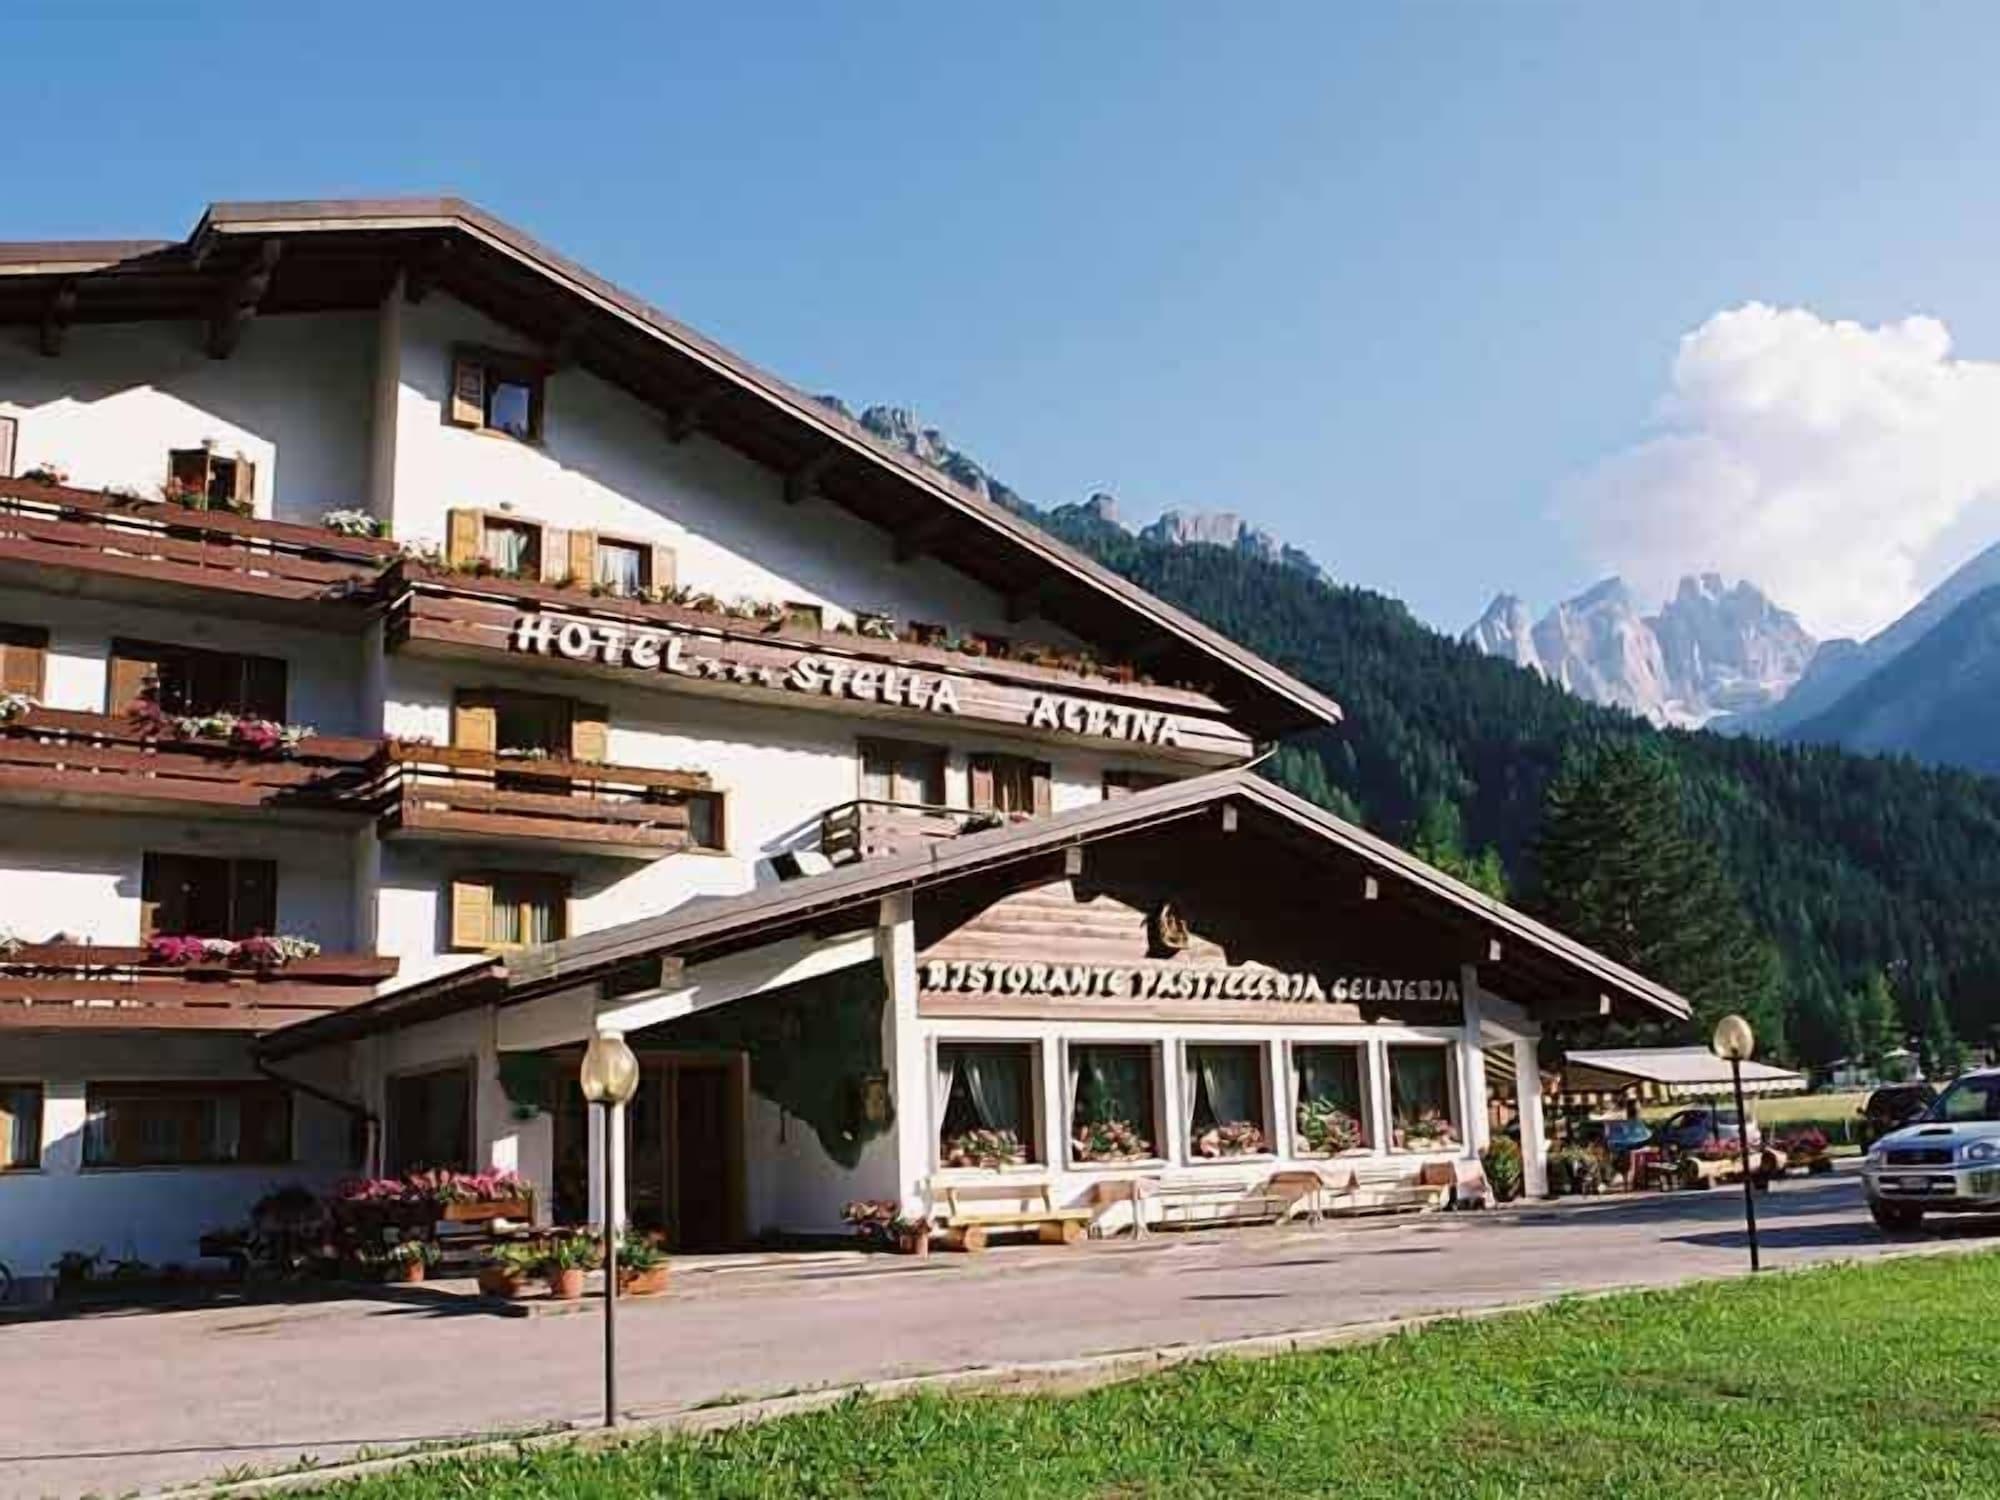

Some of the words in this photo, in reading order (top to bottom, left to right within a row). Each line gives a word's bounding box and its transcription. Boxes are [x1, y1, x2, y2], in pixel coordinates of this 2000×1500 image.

[513, 612, 689, 673] HOTEL
[790, 655, 961, 715] STELLA
[926, 960, 1126, 996] RISTORANTE
[1137, 965, 1327, 1002] PASTICCERIA
[1331, 977, 1459, 1002] GELATERIA
